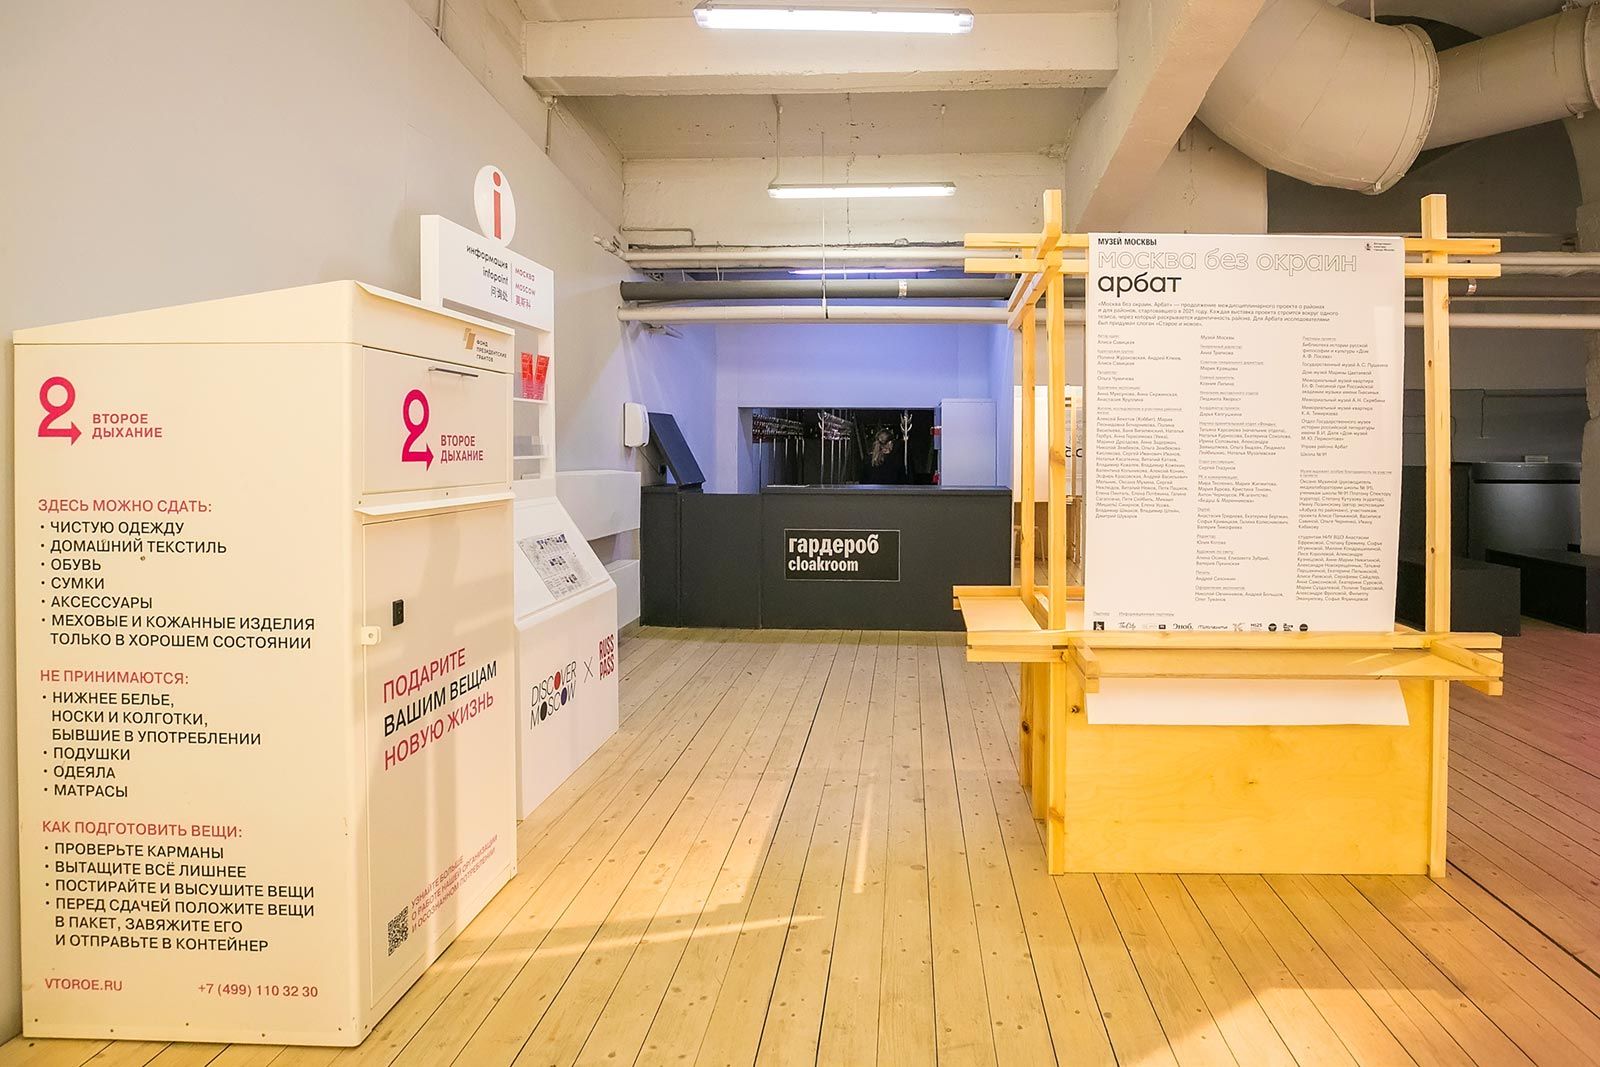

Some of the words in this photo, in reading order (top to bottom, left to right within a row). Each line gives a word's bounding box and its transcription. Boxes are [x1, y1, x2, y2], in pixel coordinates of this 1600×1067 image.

[1124, 238, 1156, 246] МОСКВЫ
[466, 245, 508, 269] информация
[1098, 251, 1197, 270] москва
[1204, 248, 1249, 271] без
[1256, 253, 1357, 277] окраин
[483, 266, 508, 285] infopoint
[1098, 271, 1182, 297] арбат
[92, 413, 148, 424] ВТОРОЕ
[92, 427, 162, 440] ДЫХАНИЕ
[440, 435, 476, 447] ВТОРОЕ
[440, 450, 483, 464] ДЫХАНИЕ
[38, 498, 88, 513] ЗДЕСЬ
[93, 499, 153, 512] МОЖНО
[157, 500, 212, 514] СДАТЬ:
[50, 521, 114, 533] ЧИСТУЮ
[118, 521, 184, 536] ОДЕЖДУ
[50, 538, 142, 554] ДОМАШНИЙ
[146, 540, 226, 553] ТЕКСТИЛЬ
[788, 534, 879, 558] гардероб
[50, 558, 101, 570] ОБУВЬ
[788, 556, 859, 572] cloakroom
[51, 576, 104, 589] СУМКИ
[51, 595, 152, 608] АКСЕССУАРЫ
[52, 614, 128, 627] МЕХОВЫЕ
[132, 615, 141, 627] И
[146, 615, 236, 629] КОЖАННЫЕ
[240, 617, 314, 632] ИЗДЕЛИЯ
[50, 632, 111, 645] ТОЛЬКО
[116, 634, 124, 646] В
[128, 634, 208, 647] ХОРОШЕМ
[213, 635, 310, 649] СОСТОЯНИИ
[599, 633, 614, 659] RUSS
[384, 648, 466, 703] ПОДАРИТЕ
[599, 654, 614, 681] PASS
[40, 669, 60, 682] НЕ
[64, 670, 188, 684] ПРИНИМАЮТСЯ:
[531, 660, 577, 707] DISCOVER
[52, 691, 117, 704] НИЖНЕЕ
[121, 692, 174, 708] БЕЛЬЕ,
[384, 687, 446, 737] ВАШИМ
[450, 660, 497, 701] ВЕЩАМ
[530, 680, 577, 729] MOSCOW
[52, 710, 104, 722] НОСКИ
[108, 711, 118, 723] И
[123, 711, 207, 727] КОЛГОТКИ,
[52, 728, 120, 742] БЫВШИЕ
[124, 730, 134, 742] В
[137, 730, 260, 745] УПОТРЕБЛЕНИИ
[384, 719, 444, 771] НОВУЮ
[448, 691, 494, 732] ЖИЗНЬ
[54, 746, 130, 762] ПОДУШКИ
[54, 765, 116, 780] ОДЕЯЛА
[54, 784, 127, 797] МАТРАСЫ
[42, 820, 70, 833] КАК
[75, 821, 187, 836] ПОДГОТОВИТЬ
[191, 824, 242, 840] ВЕЩИ:
[55, 842, 144, 856] ПРОВЕРЬТЕ
[147, 845, 223, 859] КАРМАНЫ
[55, 860, 141, 876] ВЫТАЩИТЕ
[145, 862, 175, 876] ВСЁ
[178, 864, 246, 878] ЛИШНЕЕ
[56, 879, 156, 894] ПОСТИРАЙТЕ
[160, 882, 170, 894] И
[174, 882, 264, 896] ВЫСУШИТЕ
[268, 885, 314, 900] ВЕЩИ
[56, 897, 106, 913] ПЕРЕД
[109, 898, 170, 914] СДАЧЕЙ
[175, 901, 264, 915] ПОЛОЖИТЕ
[268, 904, 314, 918] ВЕЩИ
[55, 916, 64, 927] В
[69, 916, 120, 931] ПАКЕТ,
[125, 918, 210, 932] ЗАВЯЖИТЕ
[214, 920, 242, 933] ЕГО
[56, 934, 65, 946] И
[70, 934, 158, 949] ОТПРАВЬТЕ
[162, 937, 172, 949] В
[176, 937, 268, 952] КОНТЕЙНЕР
[44, 978, 122, 991] VTOROE.RU
[198, 983, 214, 994] +7
[218, 984, 252, 997] (499)
[256, 985, 279, 997] 110
[282, 985, 298, 997] 32
[302, 986, 318, 998] 30
